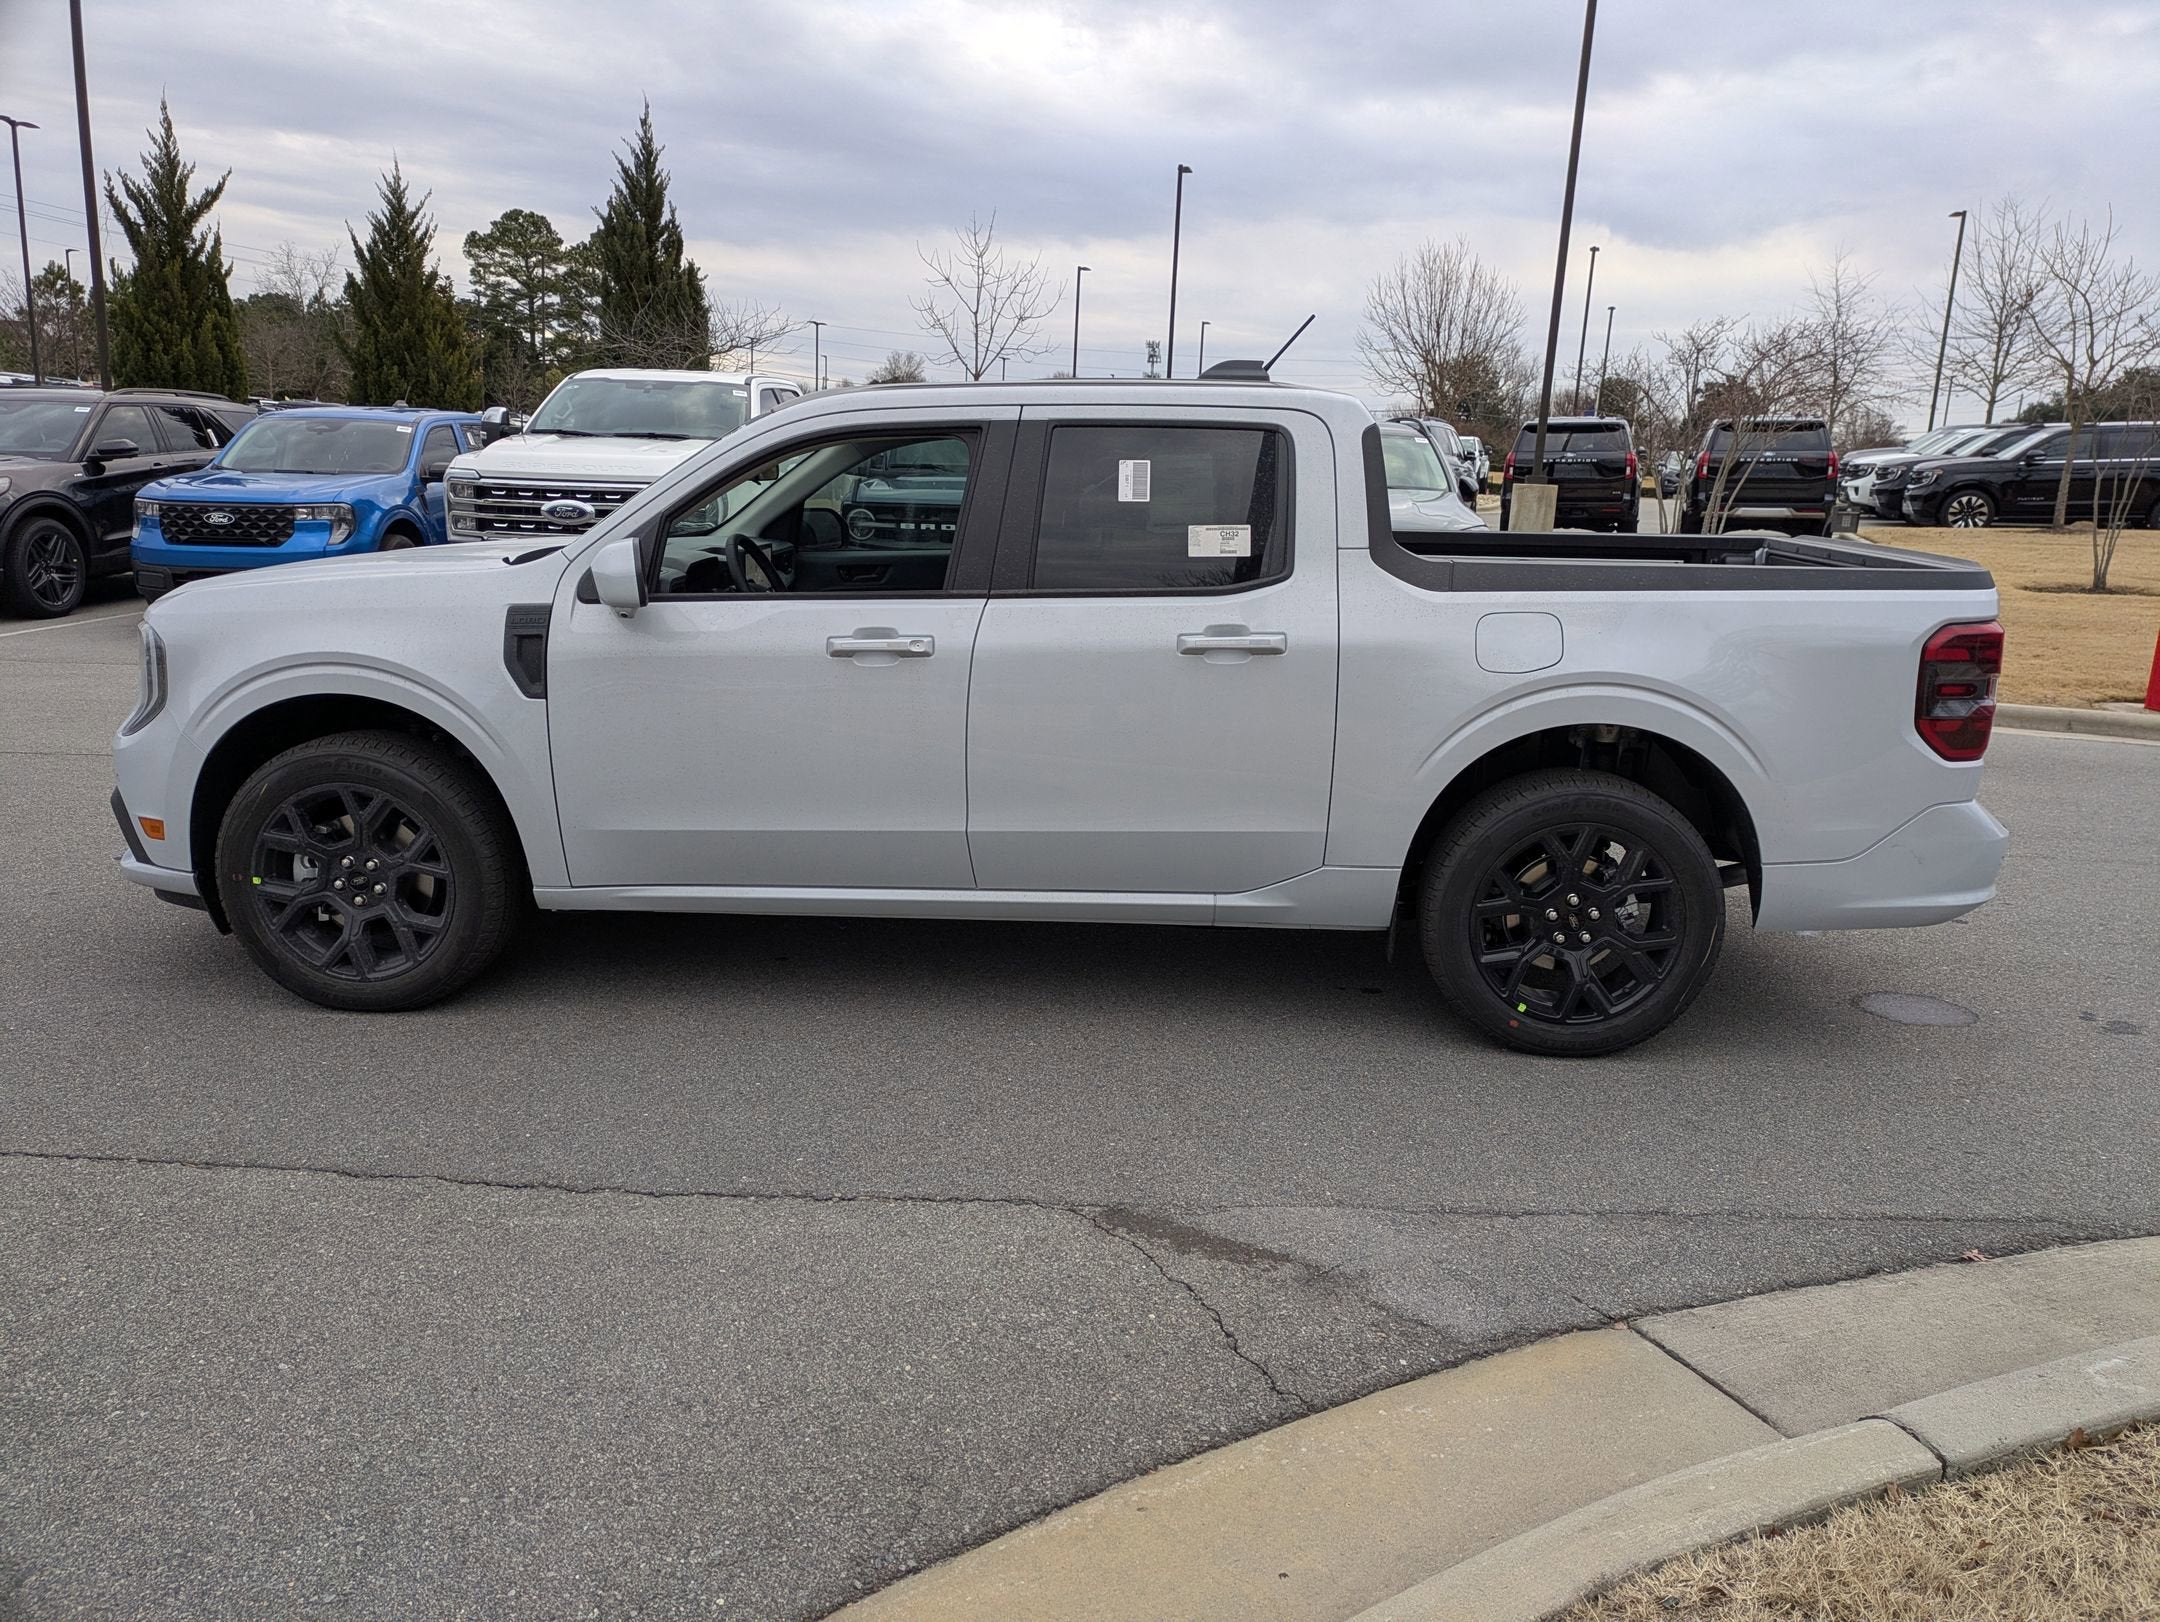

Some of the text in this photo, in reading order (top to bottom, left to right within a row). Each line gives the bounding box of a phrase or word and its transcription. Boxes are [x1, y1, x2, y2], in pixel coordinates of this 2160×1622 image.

[503, 461, 642, 472] SUPER DUTY
[554, 506, 580, 518] Ford
[209, 513, 229, 523] Ford
